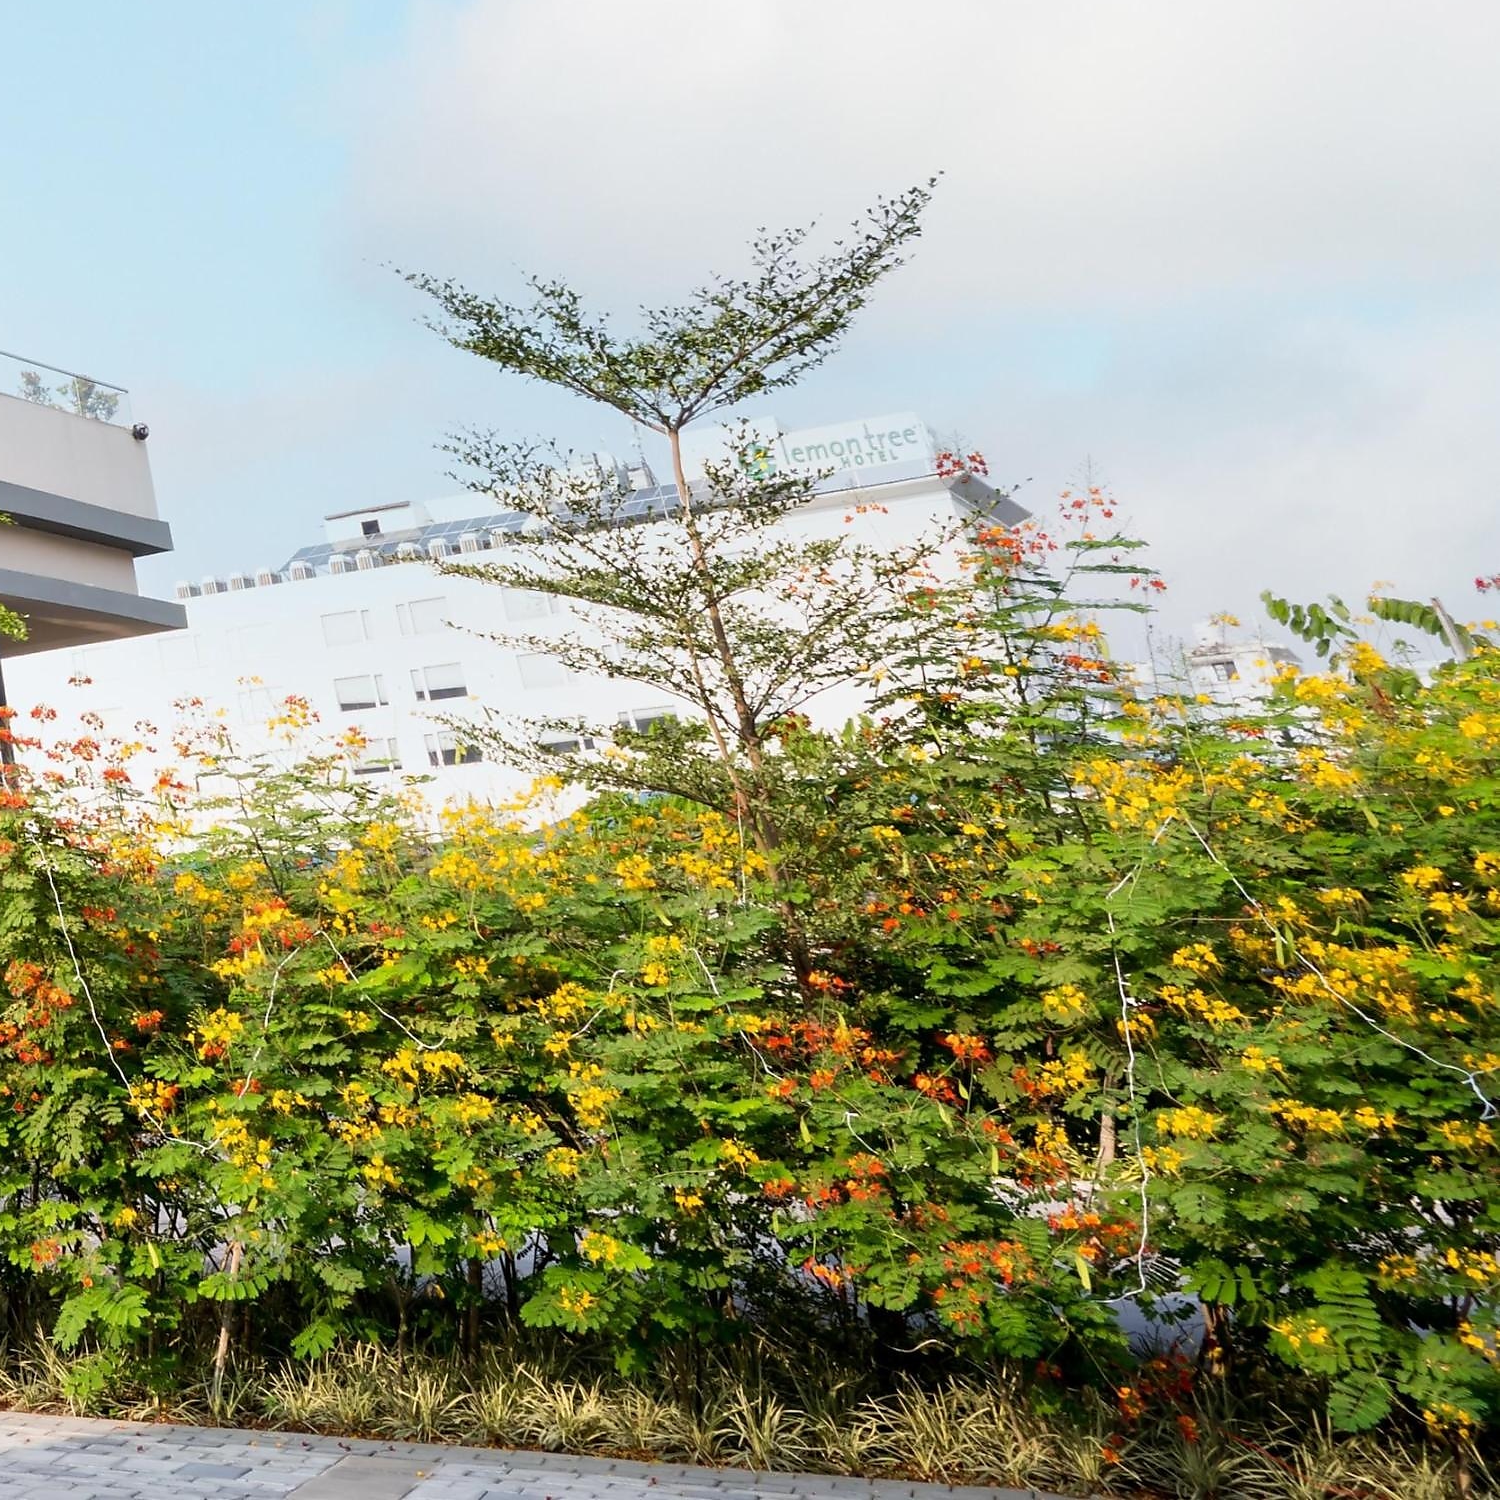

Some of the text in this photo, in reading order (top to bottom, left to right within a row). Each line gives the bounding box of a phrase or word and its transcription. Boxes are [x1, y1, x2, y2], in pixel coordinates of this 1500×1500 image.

[780, 423, 917, 465] lemon tree
[840, 449, 899, 469] HOTEL
